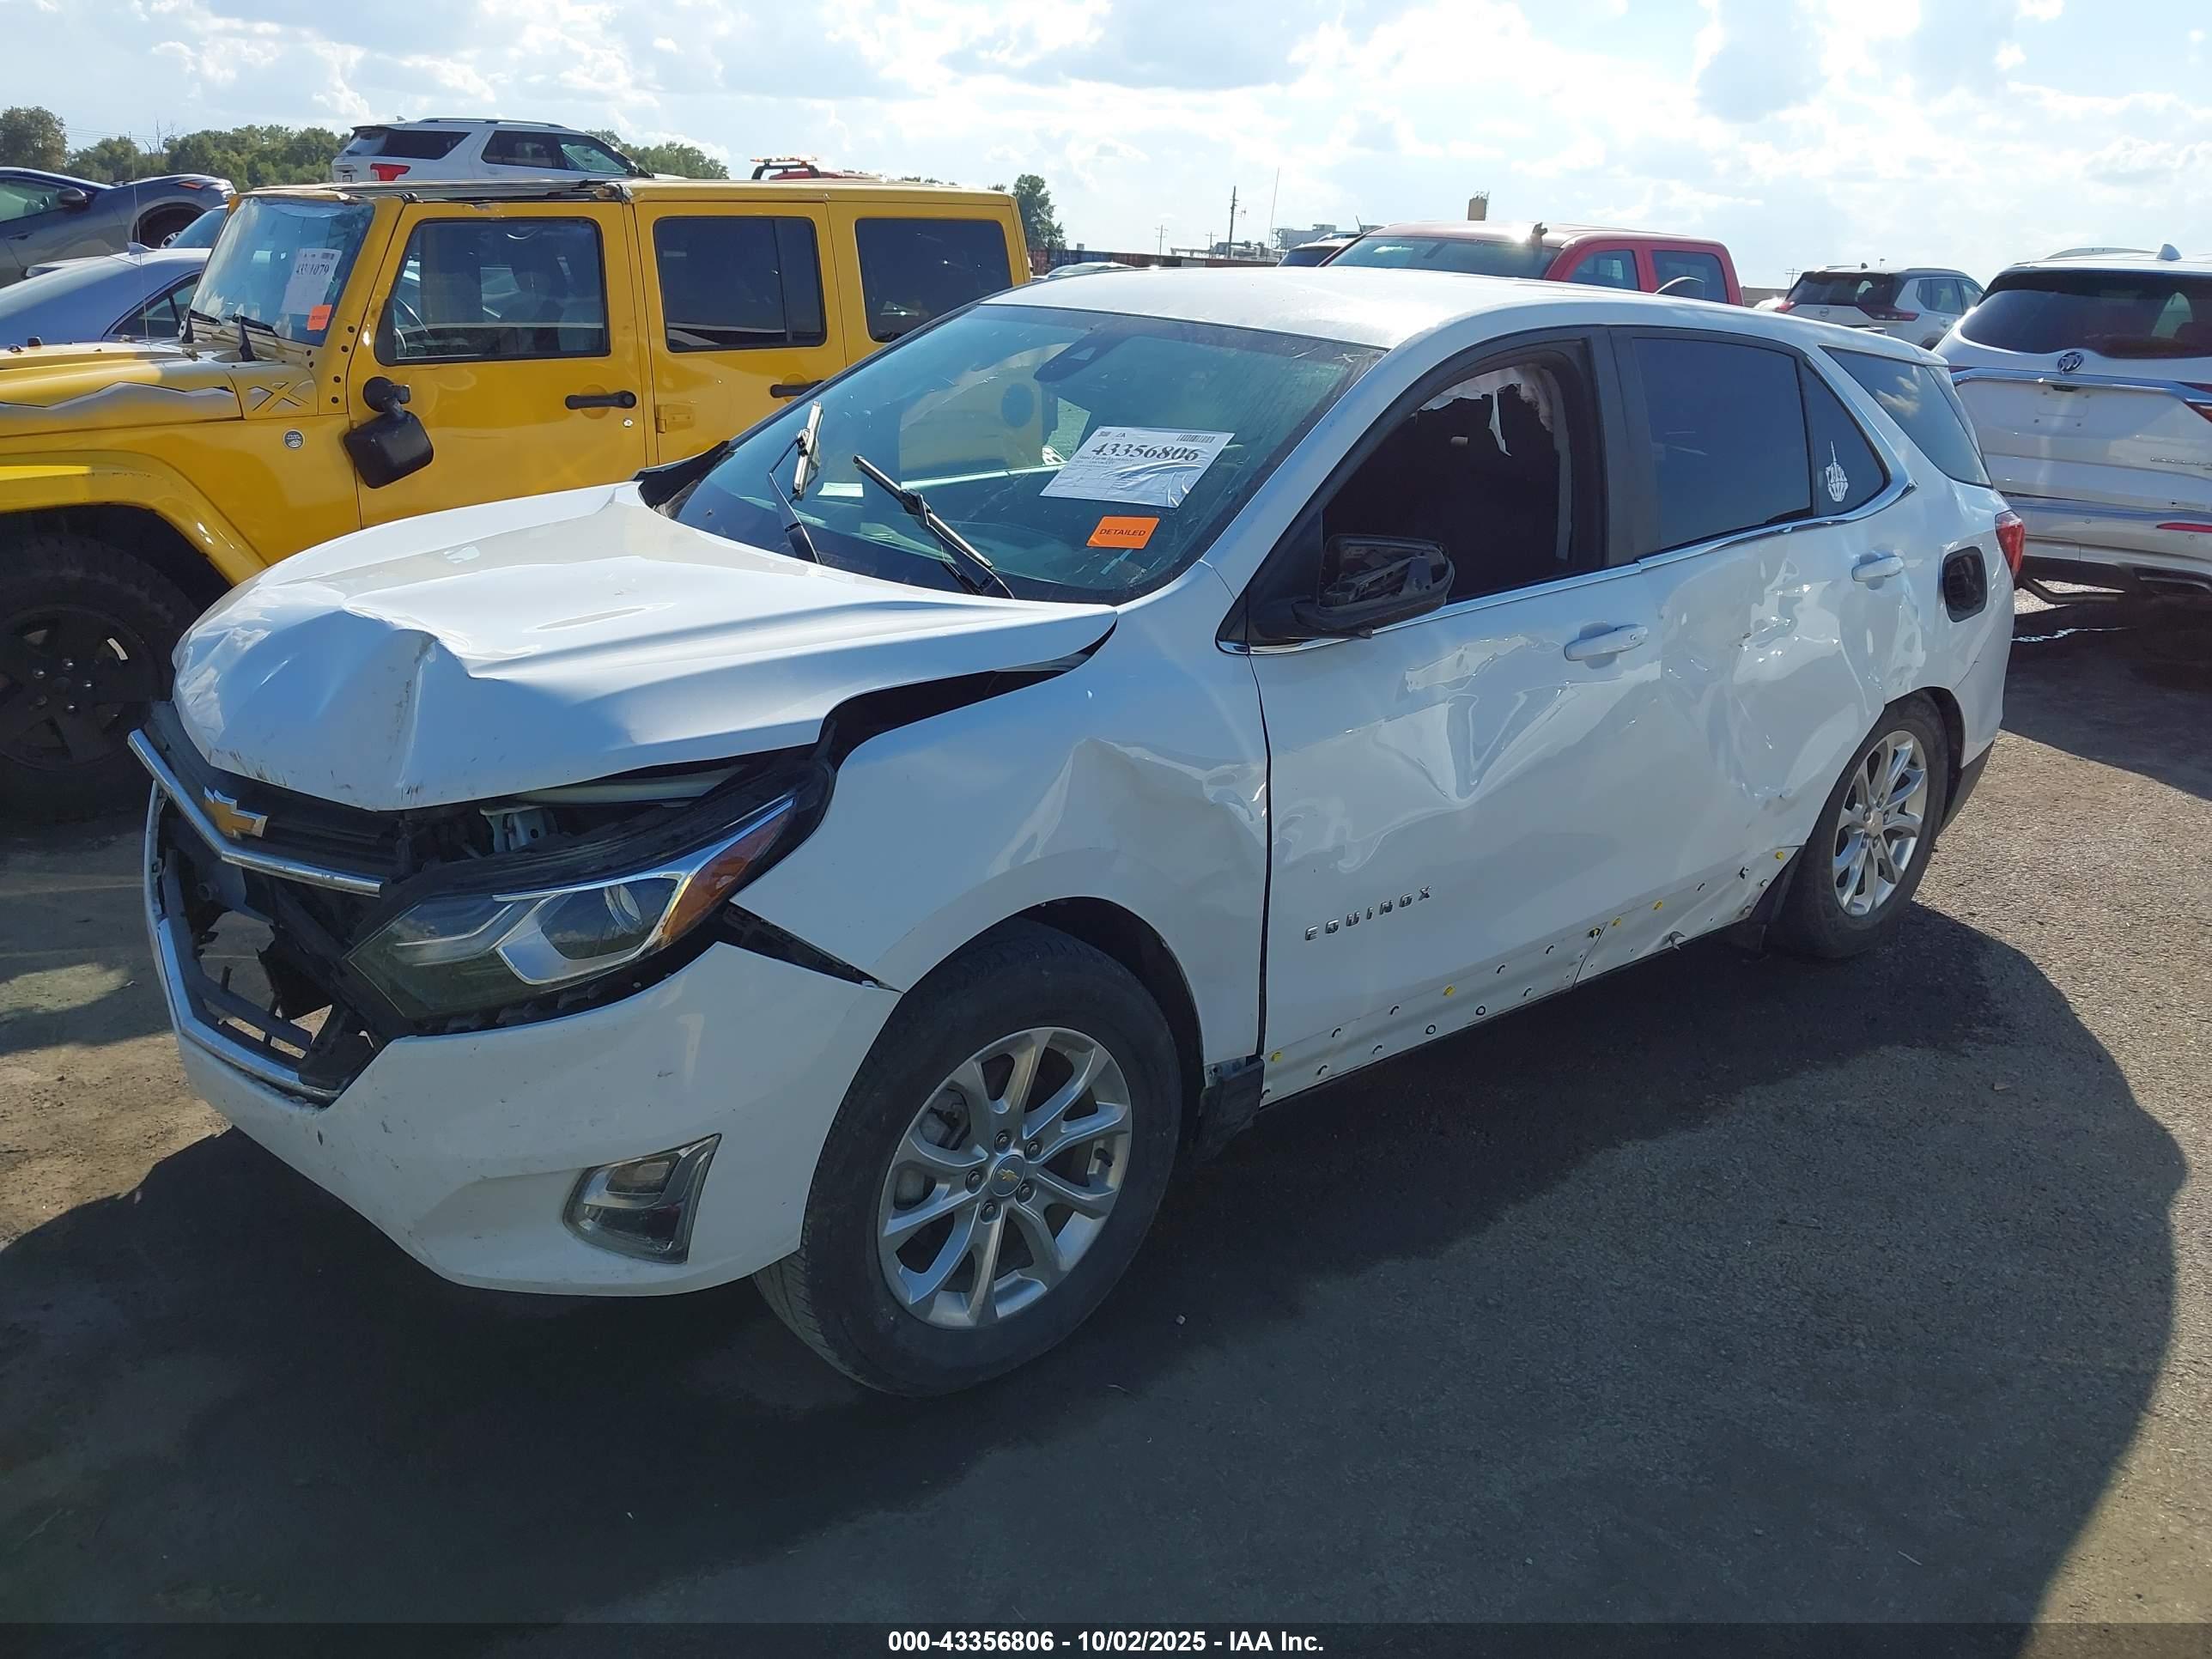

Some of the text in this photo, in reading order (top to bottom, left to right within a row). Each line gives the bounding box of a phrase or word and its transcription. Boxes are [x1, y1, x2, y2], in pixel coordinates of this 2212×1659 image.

[1091, 442, 1200, 462] 43356806
[1098, 527, 1147, 538] DETAILED
[1304, 885, 1432, 941] EQUINOX
